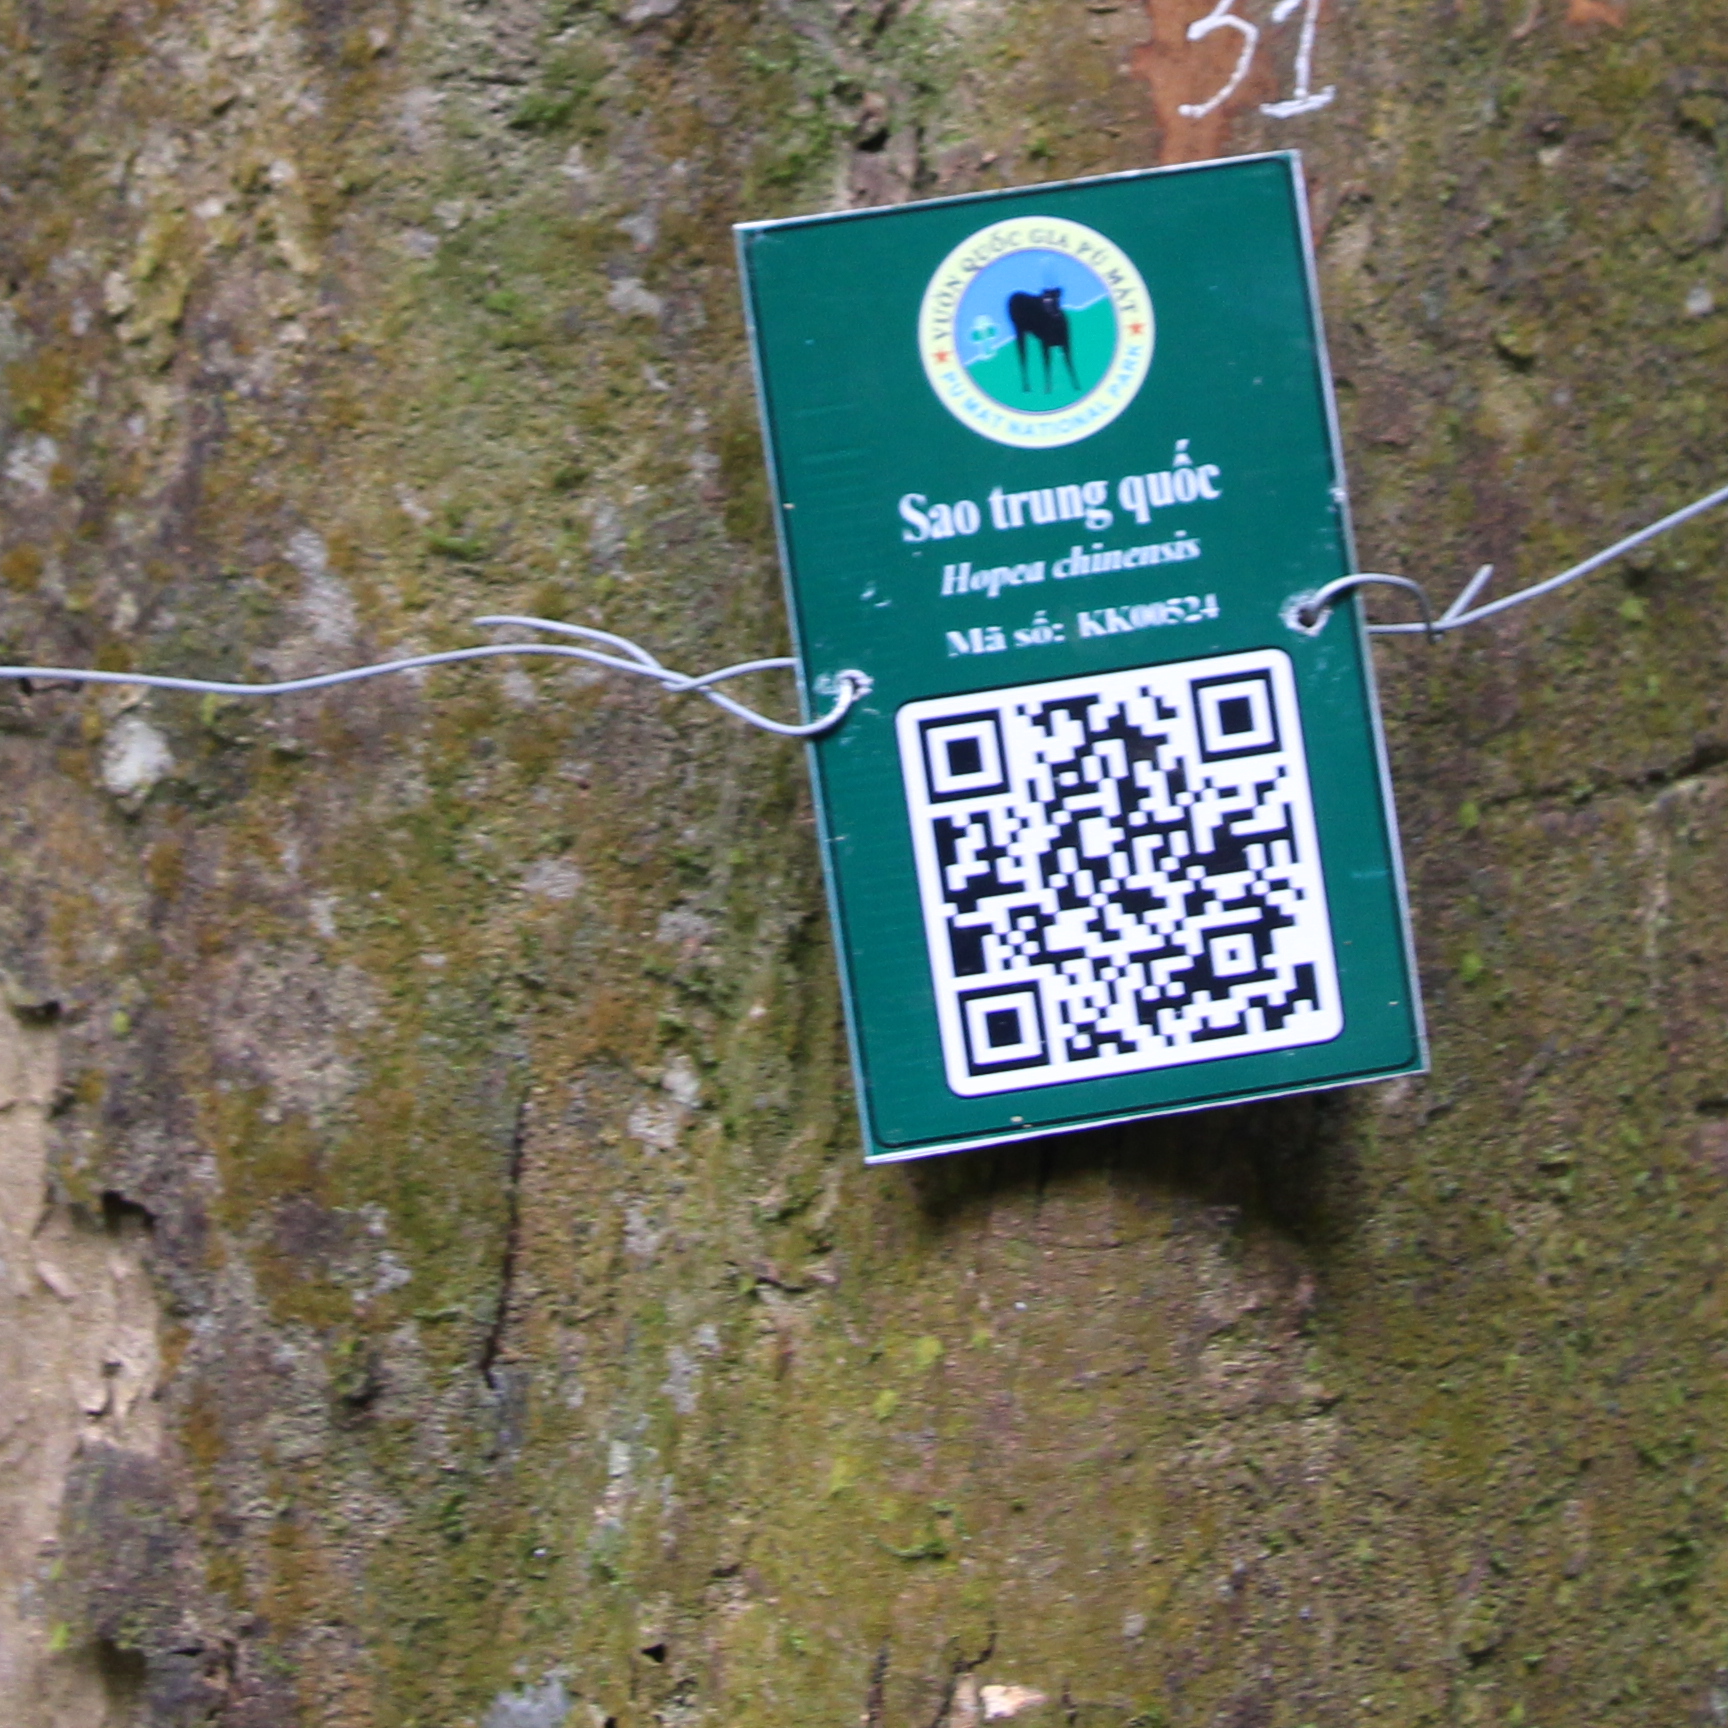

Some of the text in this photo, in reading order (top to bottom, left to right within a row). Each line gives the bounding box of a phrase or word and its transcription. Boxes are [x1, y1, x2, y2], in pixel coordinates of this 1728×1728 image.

[1027, 227, 1071, 249] GIA
[1005, 400, 1114, 437] NATIONAL
[1108, 344, 1142, 399] PARK
[898, 438, 1221, 542] Sao trung quốc
[940, 530, 1201, 598] Hopea chinensis
[945, 626, 1007, 657] Mã
[1013, 610, 1065, 647] số:
